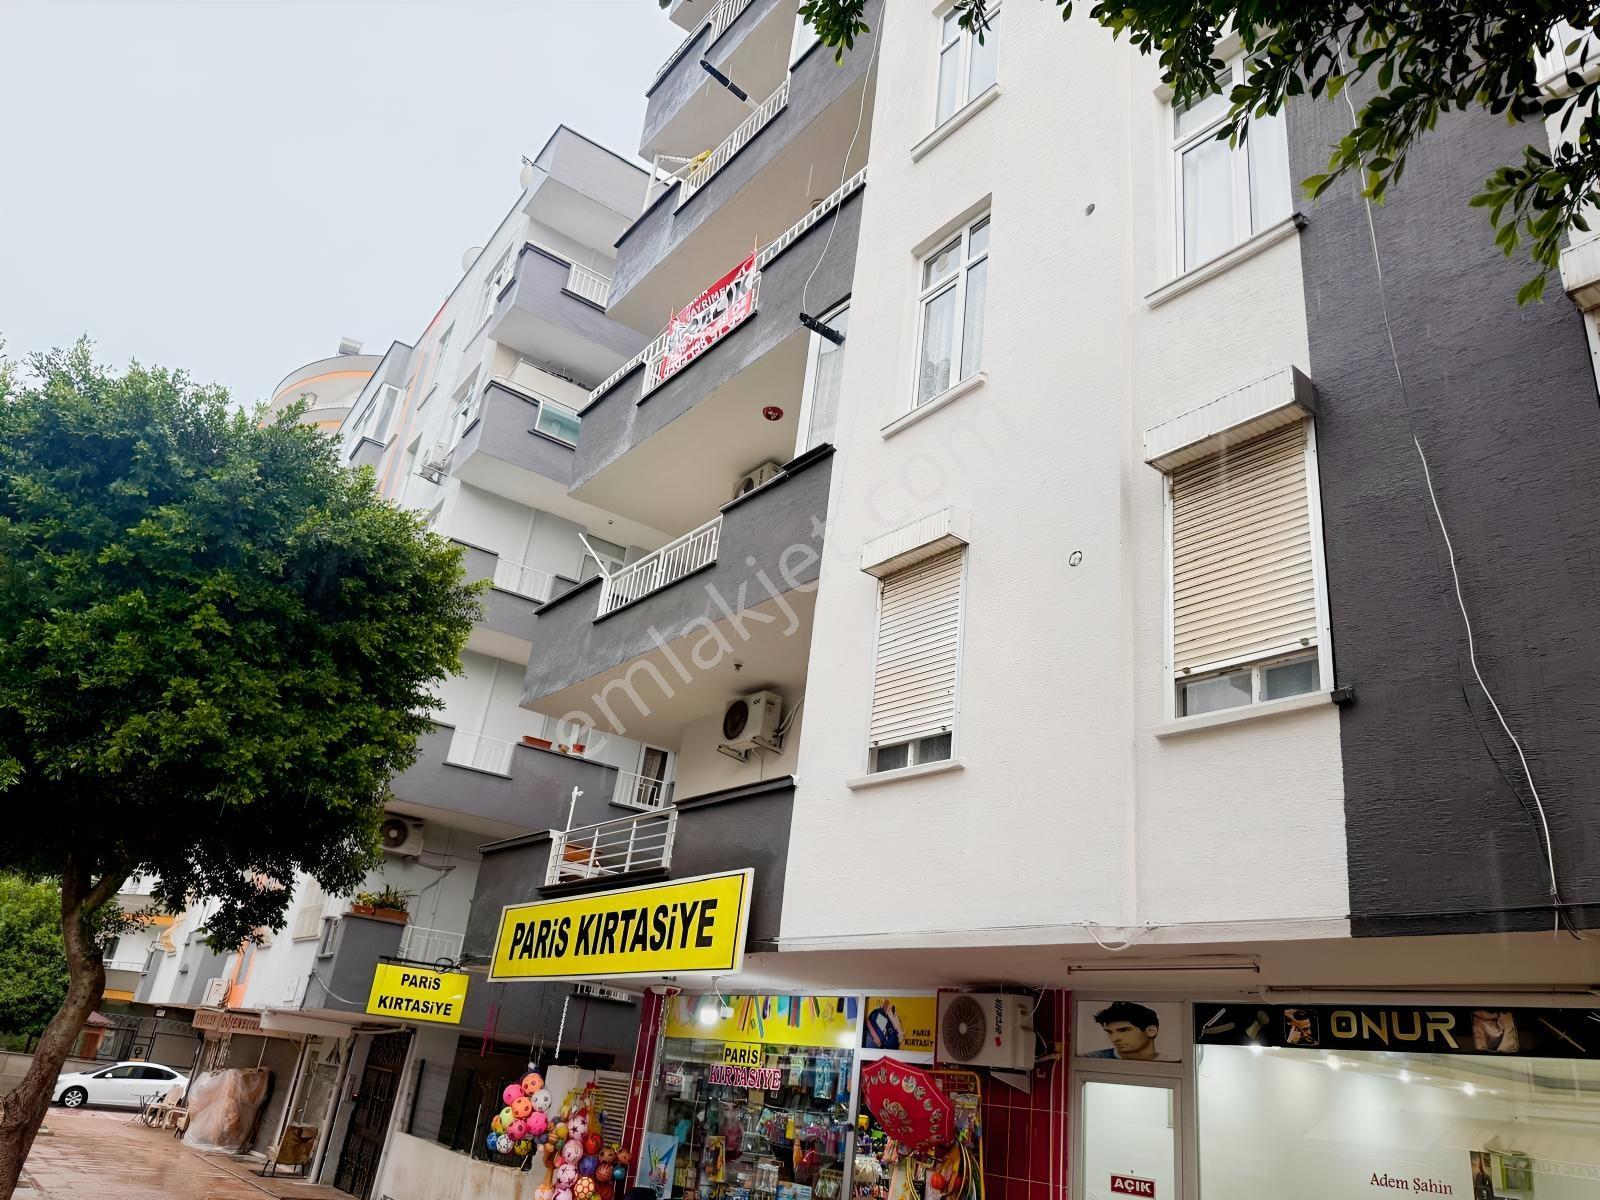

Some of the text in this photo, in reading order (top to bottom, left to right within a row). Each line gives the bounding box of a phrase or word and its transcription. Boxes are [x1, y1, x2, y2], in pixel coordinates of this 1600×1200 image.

[1330, 1010, 1460, 1049] ONUR
[1113, 1178, 1153, 1194] AÇIK
[1370, 1172, 1453, 1195] Adem Şahin
